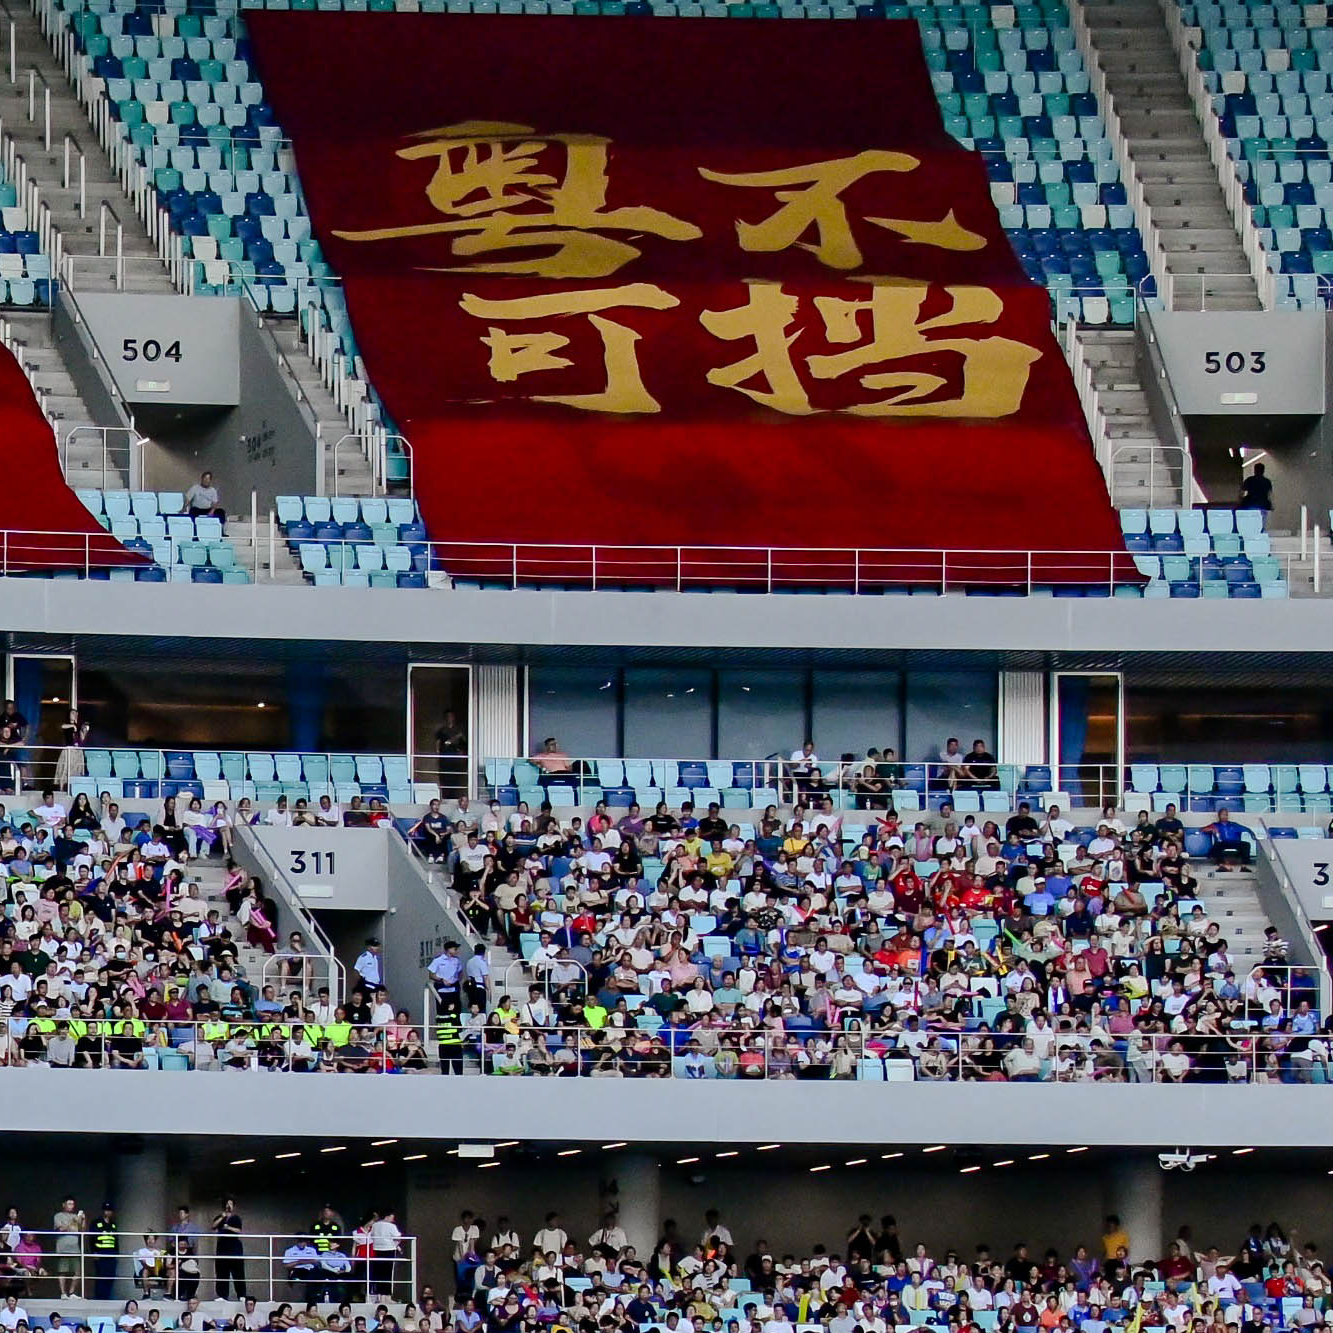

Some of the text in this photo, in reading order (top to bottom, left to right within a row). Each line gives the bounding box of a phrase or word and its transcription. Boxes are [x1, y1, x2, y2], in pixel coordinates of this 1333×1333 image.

[121, 338, 183, 363] 504
[445, 275, 1043, 417] 可挡
[1204, 350, 1267, 375] 503
[290, 850, 334, 874] 311
